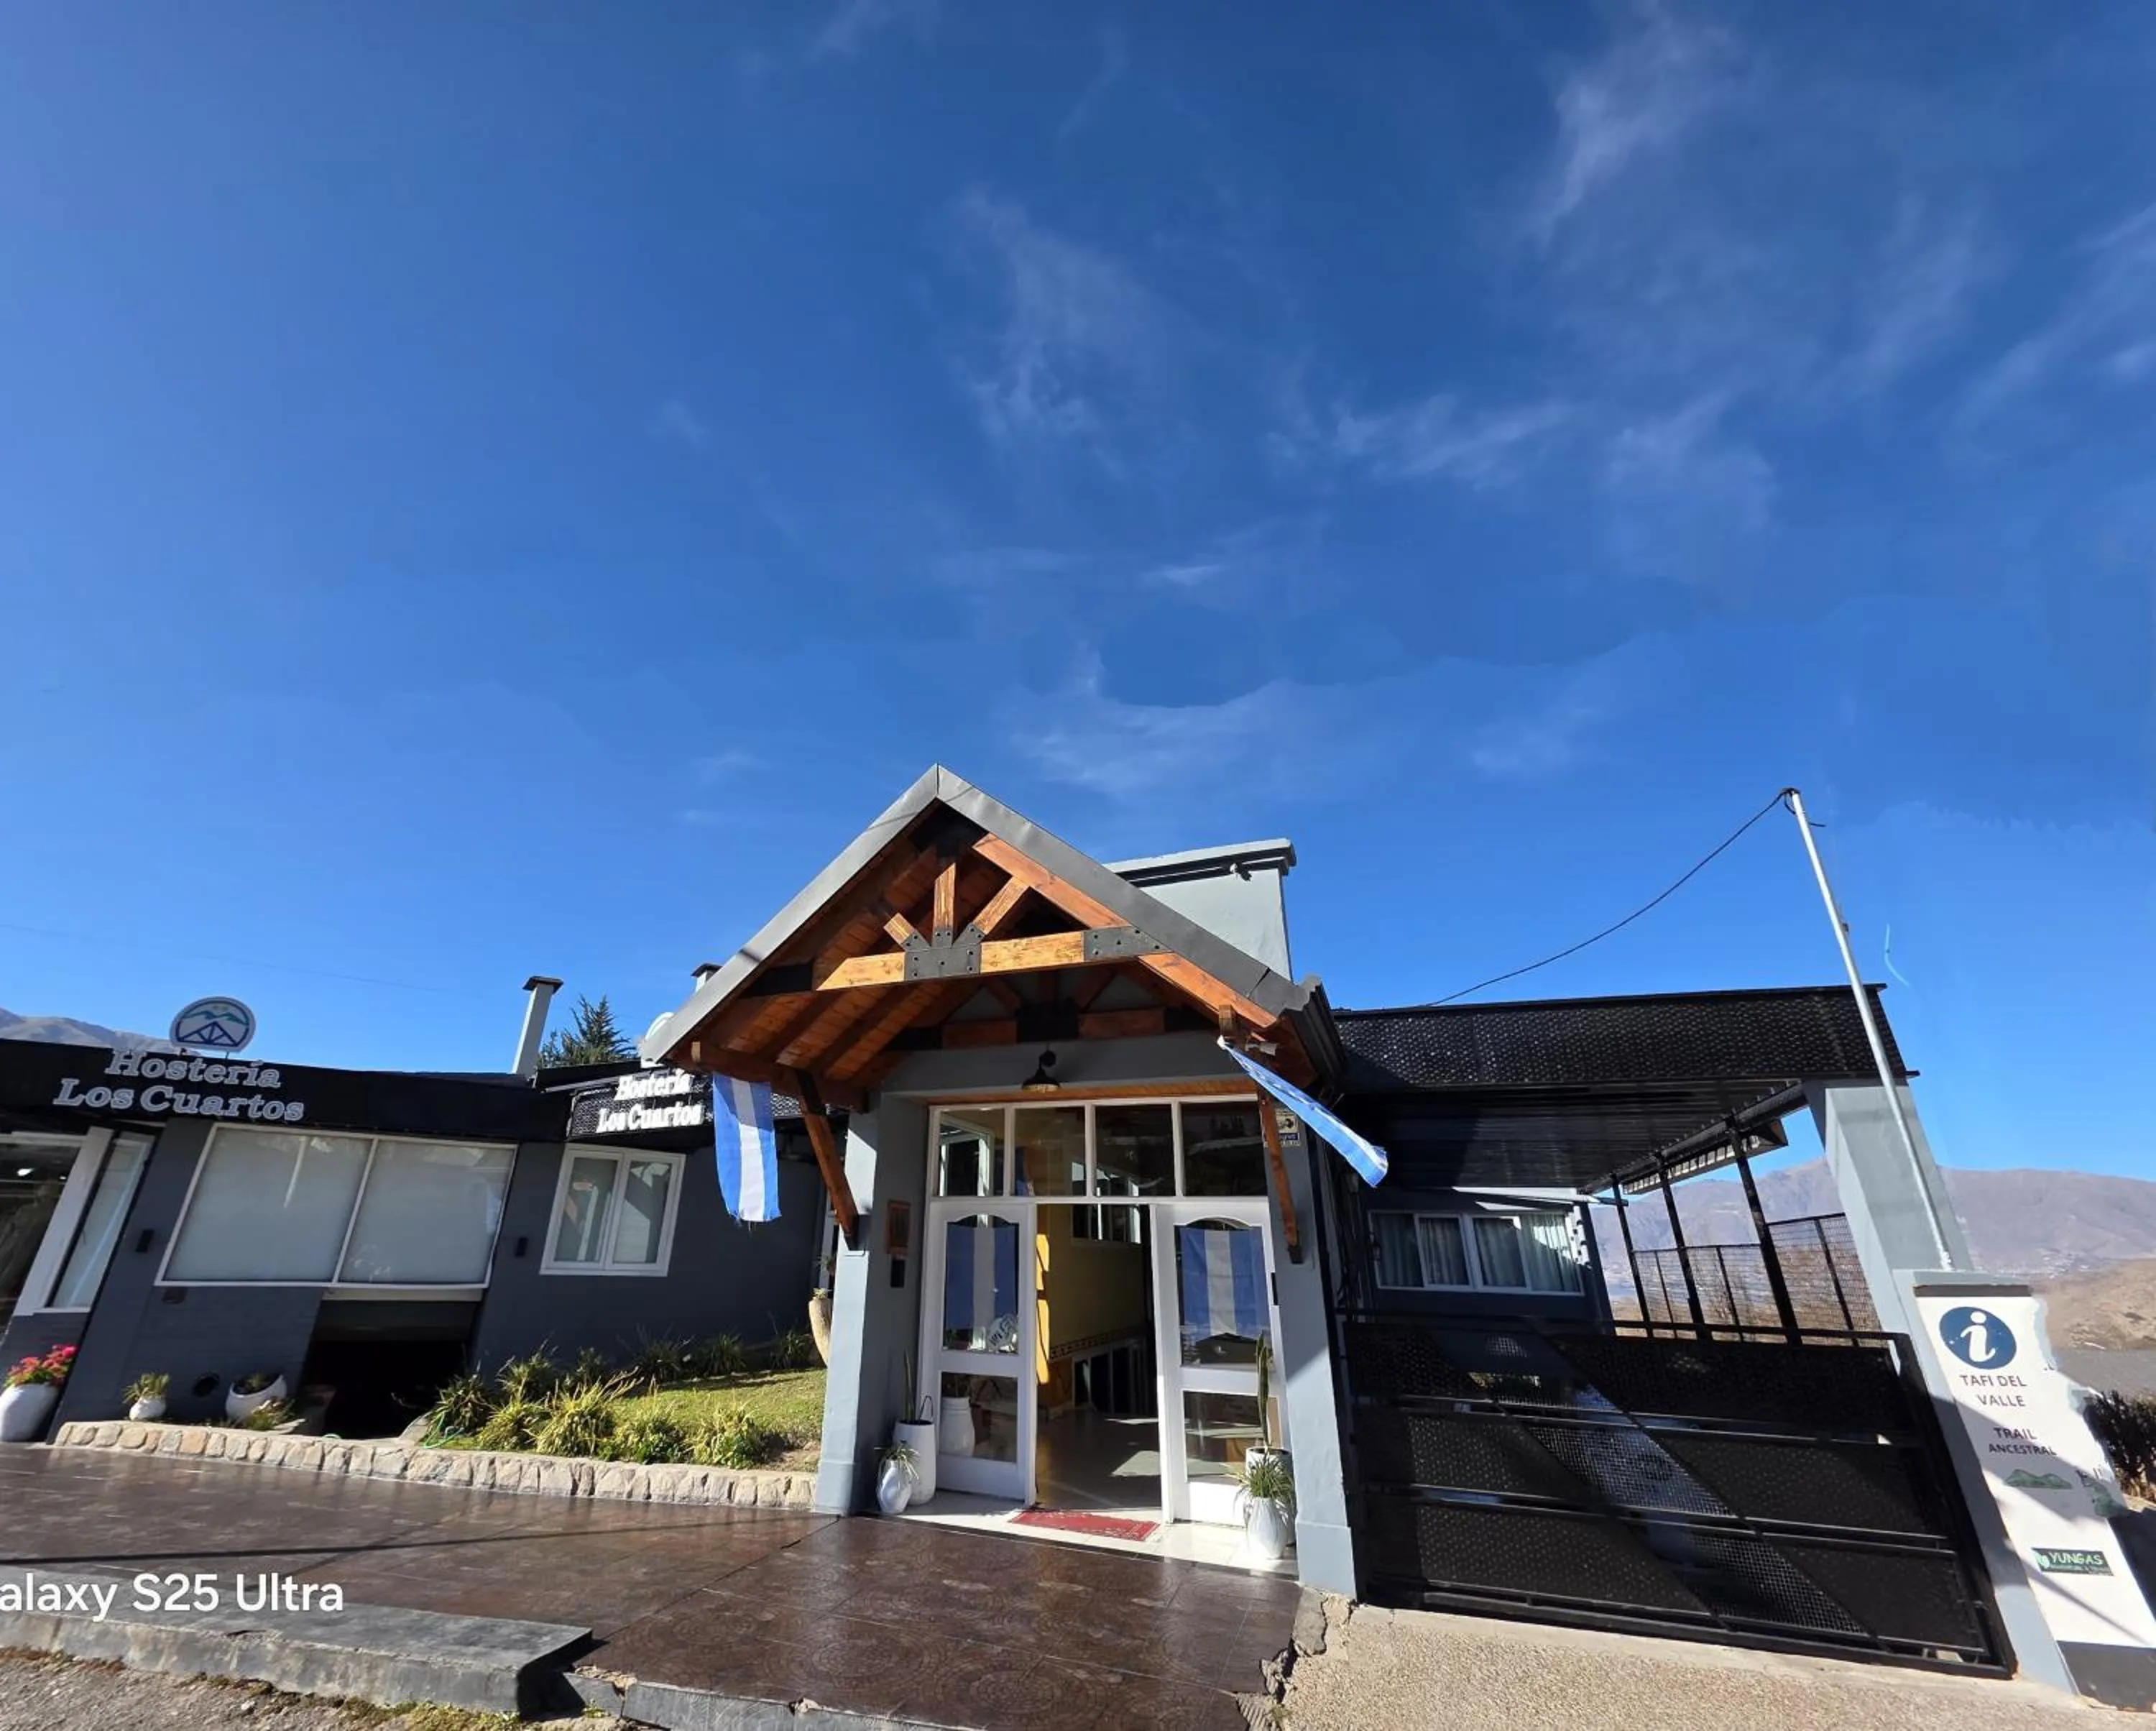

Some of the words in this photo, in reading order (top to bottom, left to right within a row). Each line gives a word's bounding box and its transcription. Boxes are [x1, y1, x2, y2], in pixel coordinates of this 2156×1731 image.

[104, 1048, 281, 1088] Hostería
[52, 1078, 135, 1109] Los
[139, 1085, 305, 1121] Cuartos
[1960, 1374, 1994, 1387] TAFI
[1997, 1375, 2027, 1387] DEL
[1977, 1394, 2026, 1407] VALLE
[1994, 1427, 2037, 1440] TRAIL
[1989, 1443, 2057, 1456] ANCESTRAL
[2047, 1552, 2104, 1565] YUNGAS
